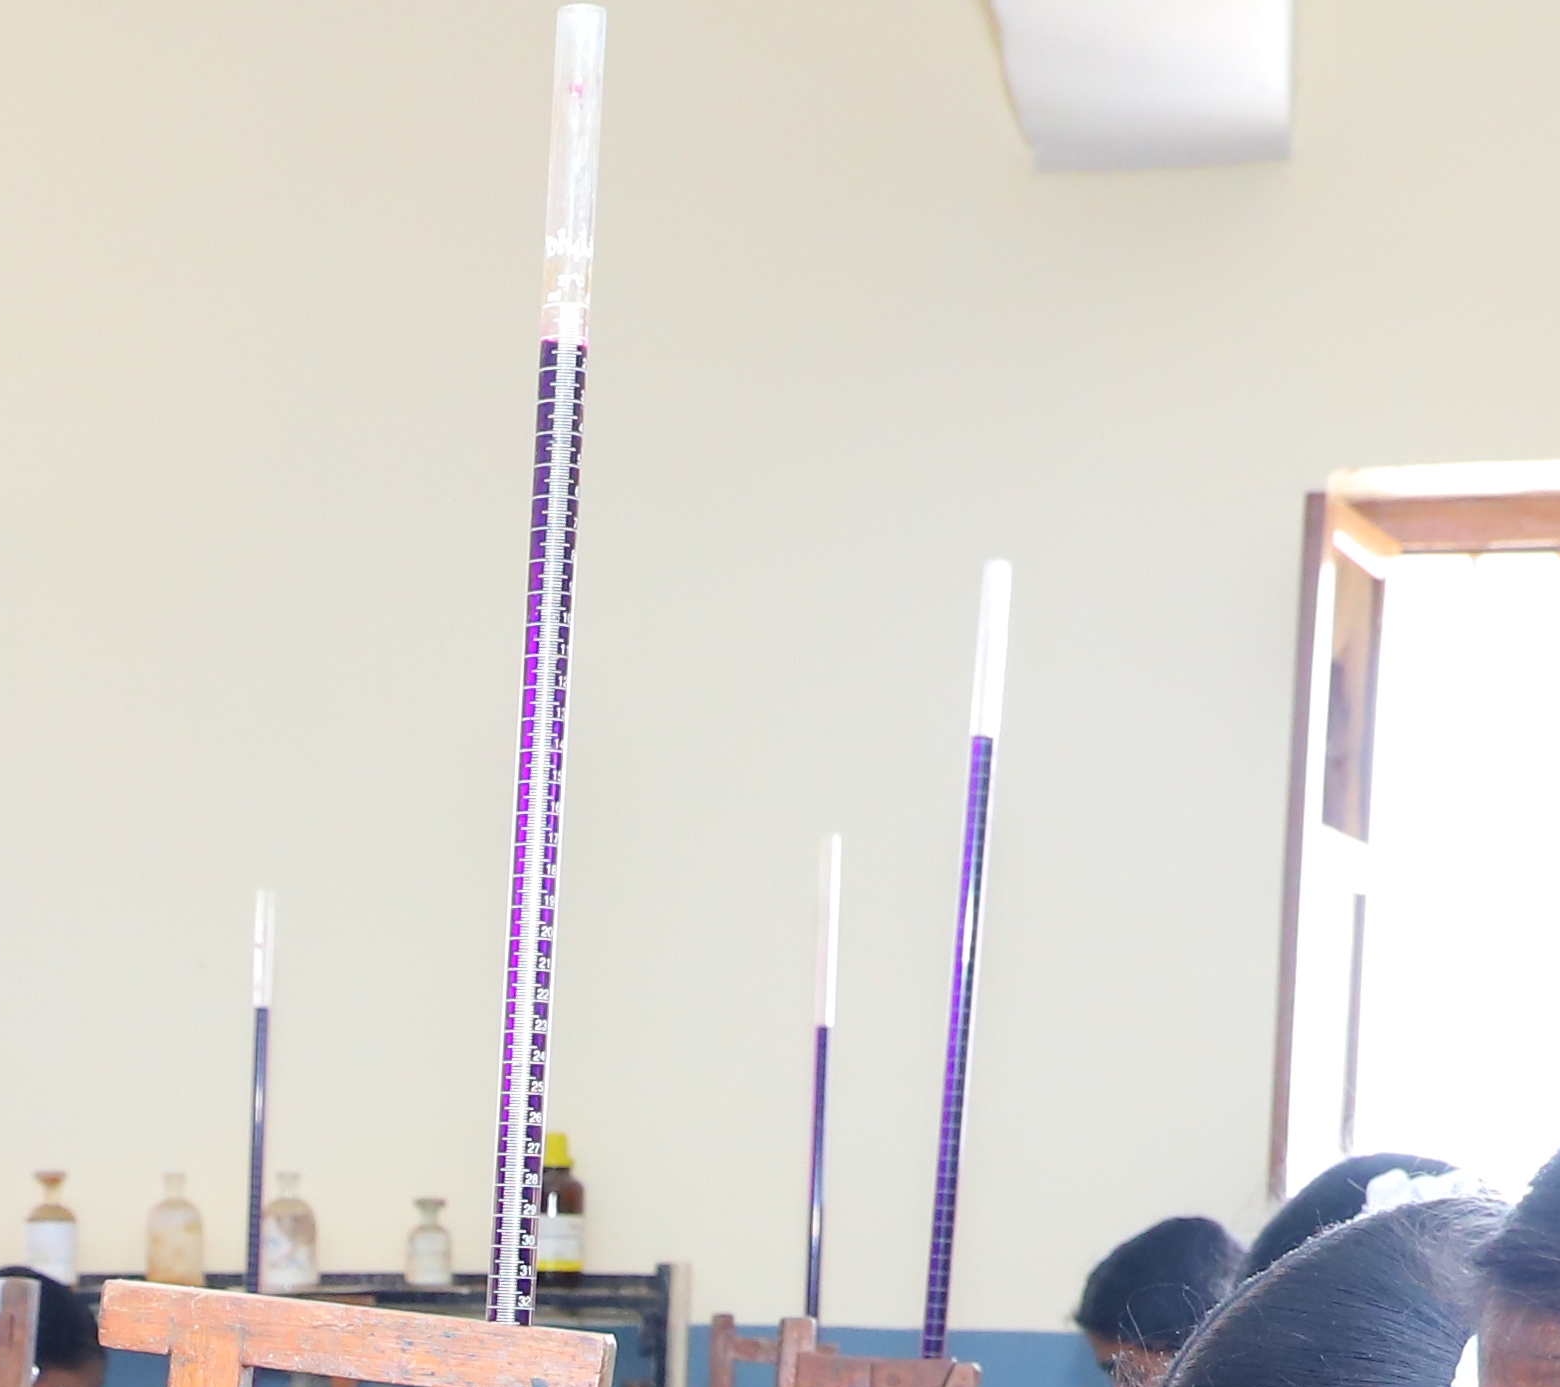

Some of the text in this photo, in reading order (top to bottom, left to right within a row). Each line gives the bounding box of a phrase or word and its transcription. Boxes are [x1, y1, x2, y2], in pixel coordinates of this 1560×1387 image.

[540, 925, 553, 938] 20
[538, 956, 551, 970] 21
[536, 988, 549, 1001] 22
[534, 1018, 548, 1032] 23
[532, 1049, 546, 1062] 24
[530, 1080, 544, 1093] 25
[528, 1111, 542, 1124] 26
[527, 1142, 540, 1154] 27
[525, 1172, 539, 1185] 28
[523, 1203, 537, 1216] 29
[521, 1234, 536, 1247] 30
[519, 1264, 532, 1277] 31
[517, 1295, 531, 1308] 32
